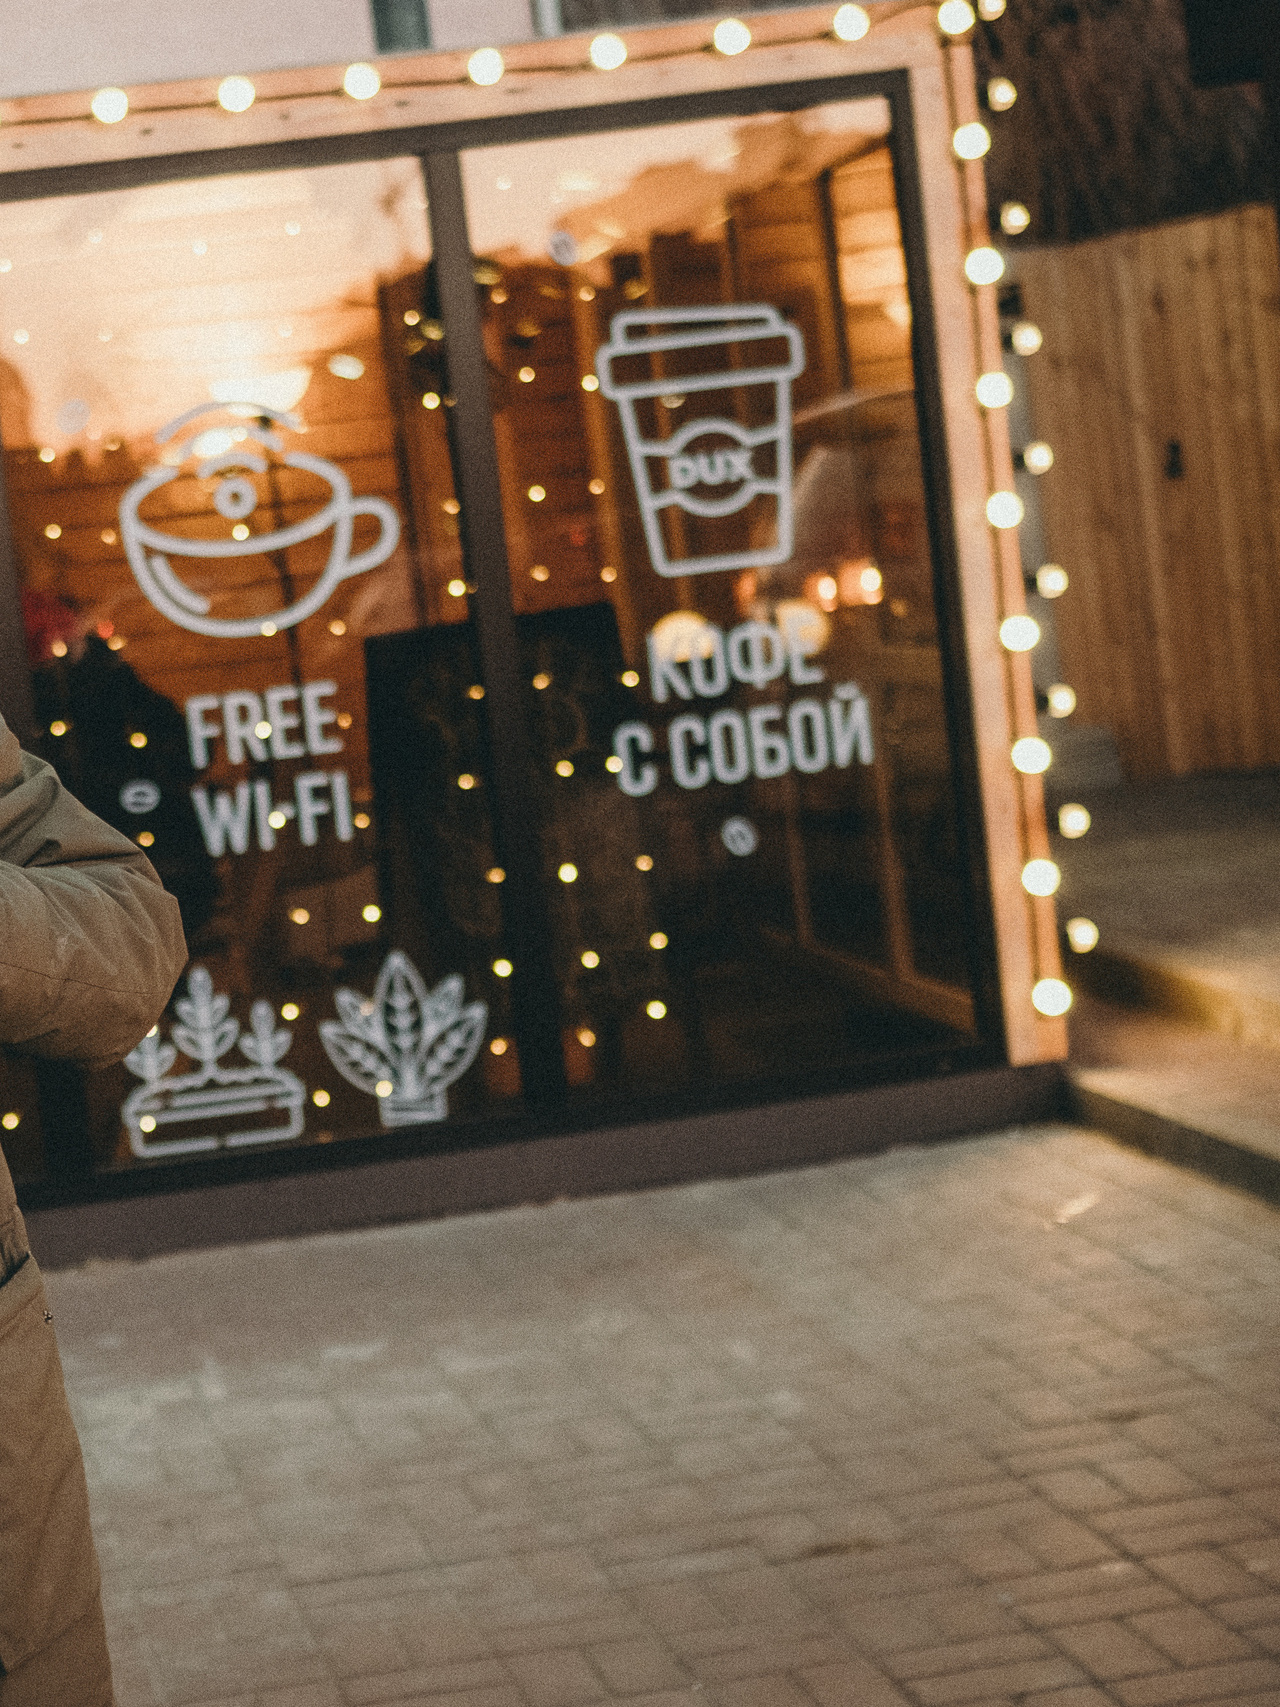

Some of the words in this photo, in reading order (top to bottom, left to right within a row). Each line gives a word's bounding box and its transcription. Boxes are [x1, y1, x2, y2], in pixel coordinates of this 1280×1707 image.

[646, 608, 826, 703] КОФЕ
[184, 679, 345, 769] FREE
[669, 681, 874, 790] СОБОЙ
[190, 769, 355, 858] WI-FI
